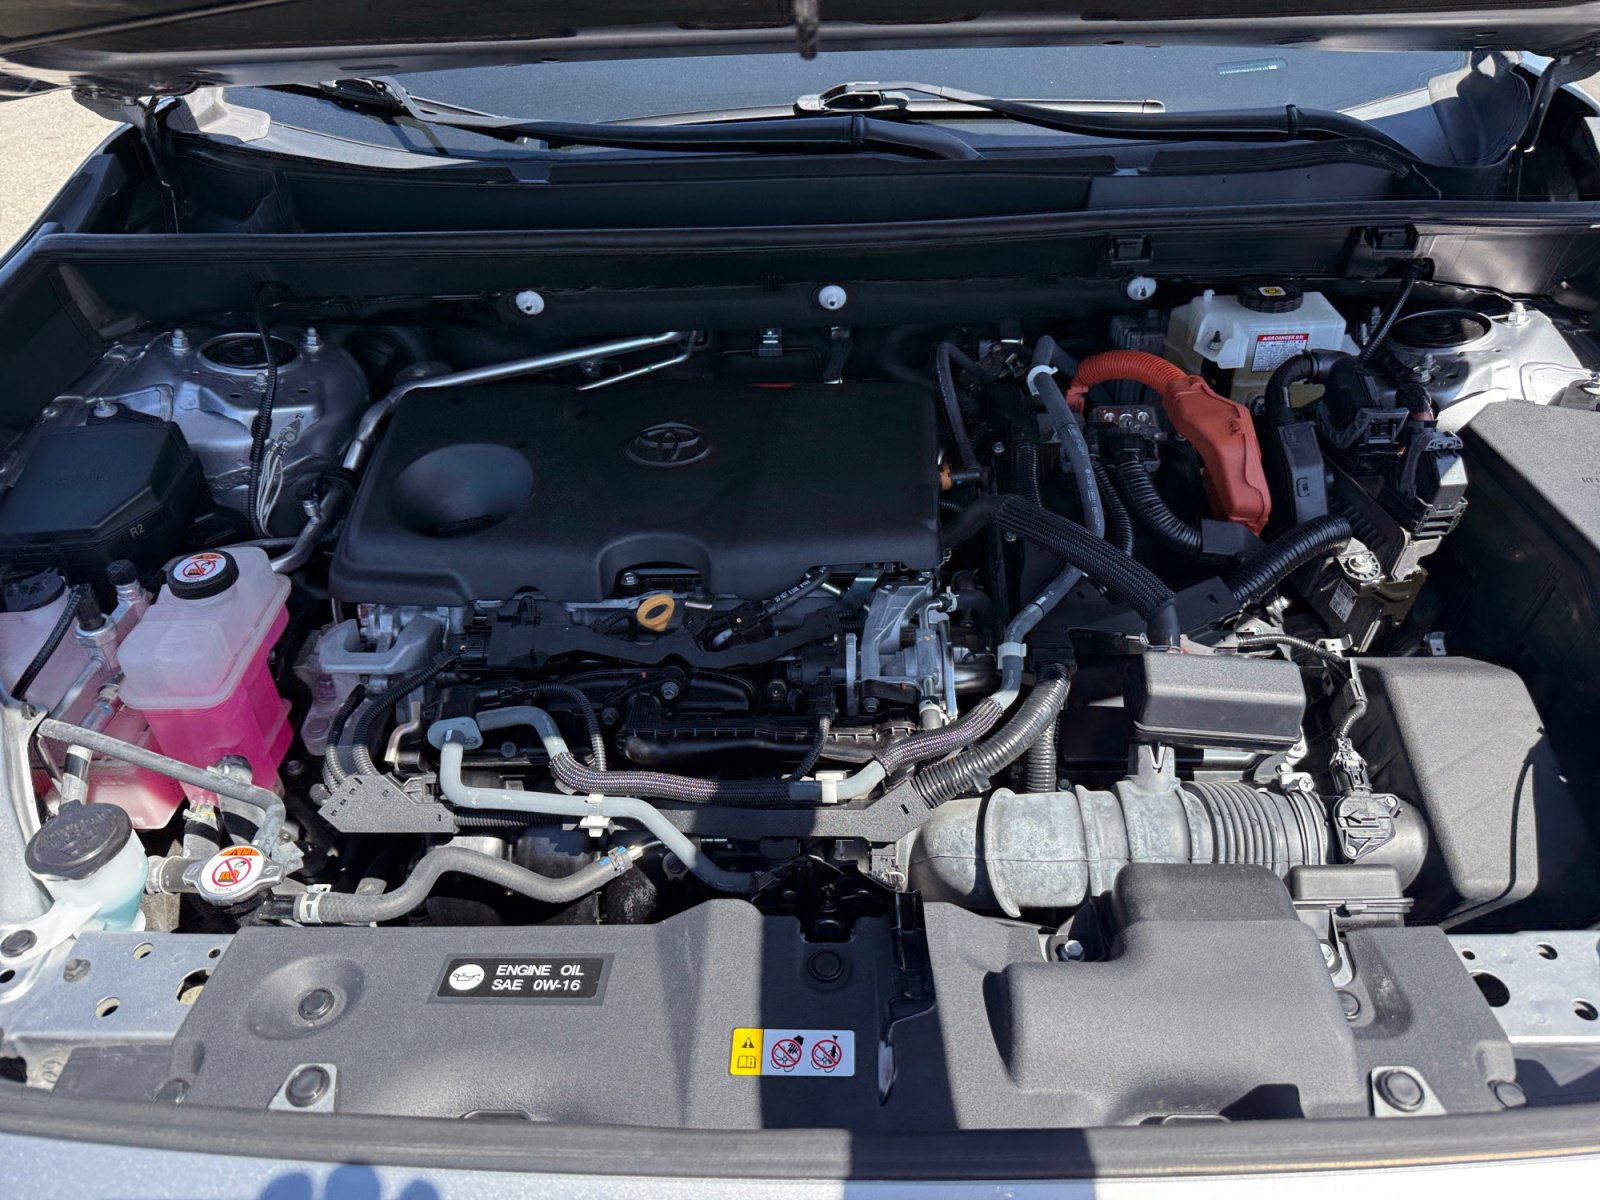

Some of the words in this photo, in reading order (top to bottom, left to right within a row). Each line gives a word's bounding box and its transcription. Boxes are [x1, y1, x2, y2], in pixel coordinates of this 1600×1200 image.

[130, 524, 144, 537] R2
[496, 964, 552, 976] ENGINE
[560, 964, 584, 976] OIL
[491, 979, 524, 991] SAE
[533, 979, 581, 991] 0W-16
